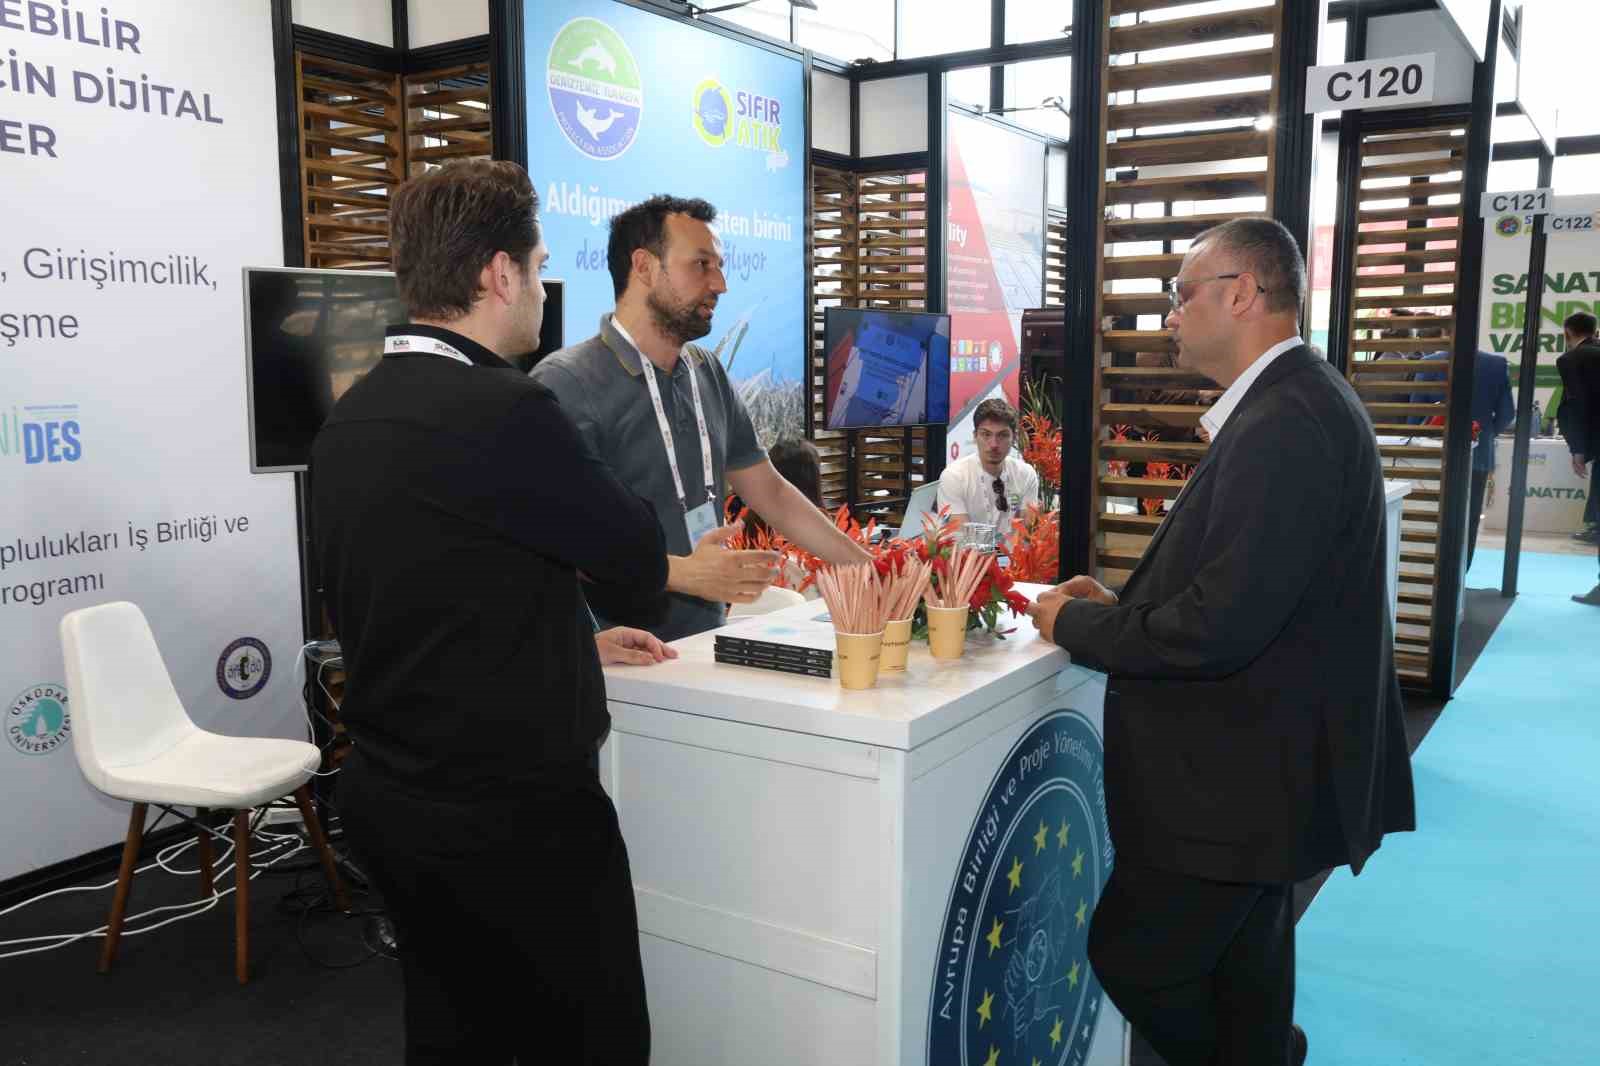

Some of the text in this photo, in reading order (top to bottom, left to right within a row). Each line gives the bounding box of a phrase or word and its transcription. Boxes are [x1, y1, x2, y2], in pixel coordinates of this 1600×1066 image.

[0, 48, 224, 124] İN DİJİTAL
[1327, 63, 1423, 102] C120
[0, 119, 58, 158] ER
[737, 119, 784, 152] ATIK
[1492, 192, 1547, 212] C121
[752, 208, 792, 241] birini
[1552, 216, 1593, 230] C122
[23, 246, 217, 290] Girişimcilik,
[0, 313, 79, 347] şme
[0, 515, 249, 570] plulukları İş Birliği ve
[2, 572, 105, 606] rogramı
[940, 907, 968, 1020] Avrupa
[963, 804, 1000, 894] Birliği
[1001, 777, 1017, 805] ve
